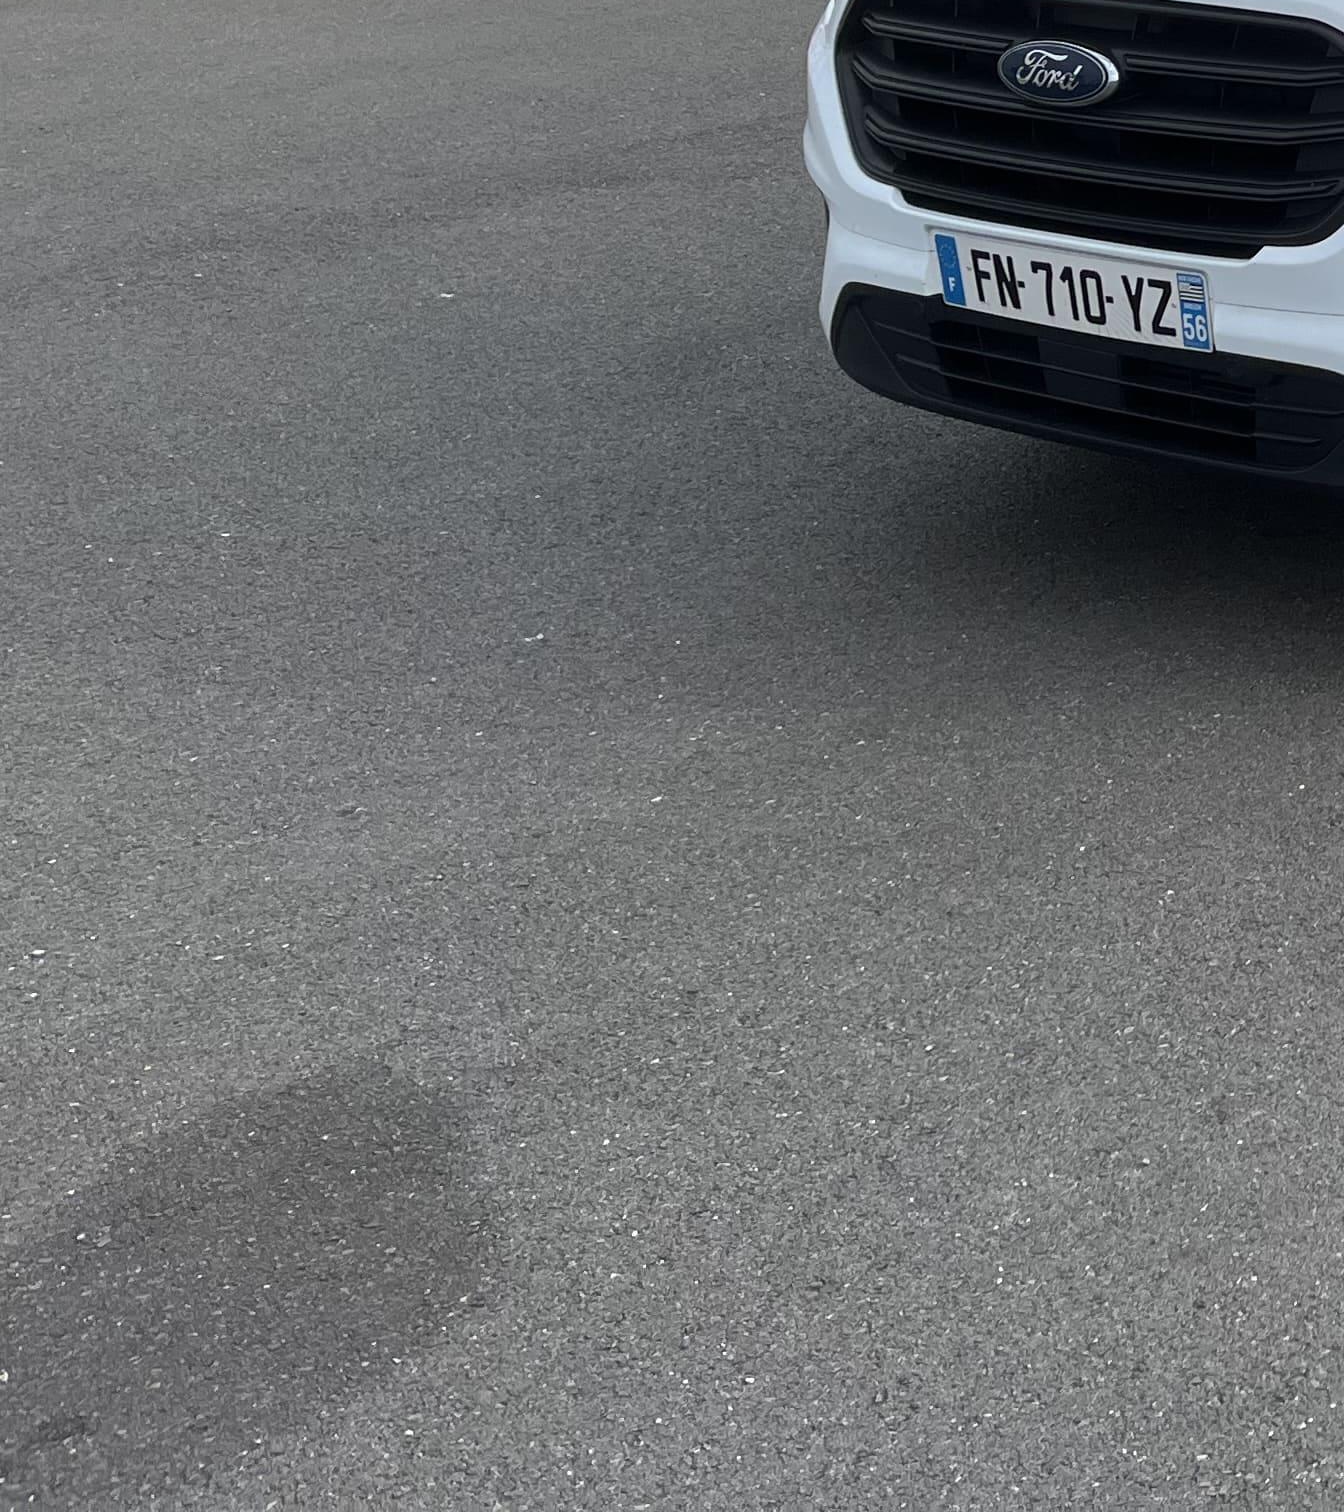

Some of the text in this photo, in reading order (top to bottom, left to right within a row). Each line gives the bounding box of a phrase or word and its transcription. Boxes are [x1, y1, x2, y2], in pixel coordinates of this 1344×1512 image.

[1016, 49, 1083, 91] Ford
[948, 277, 956, 292] F
[1183, 313, 1208, 342] 56
